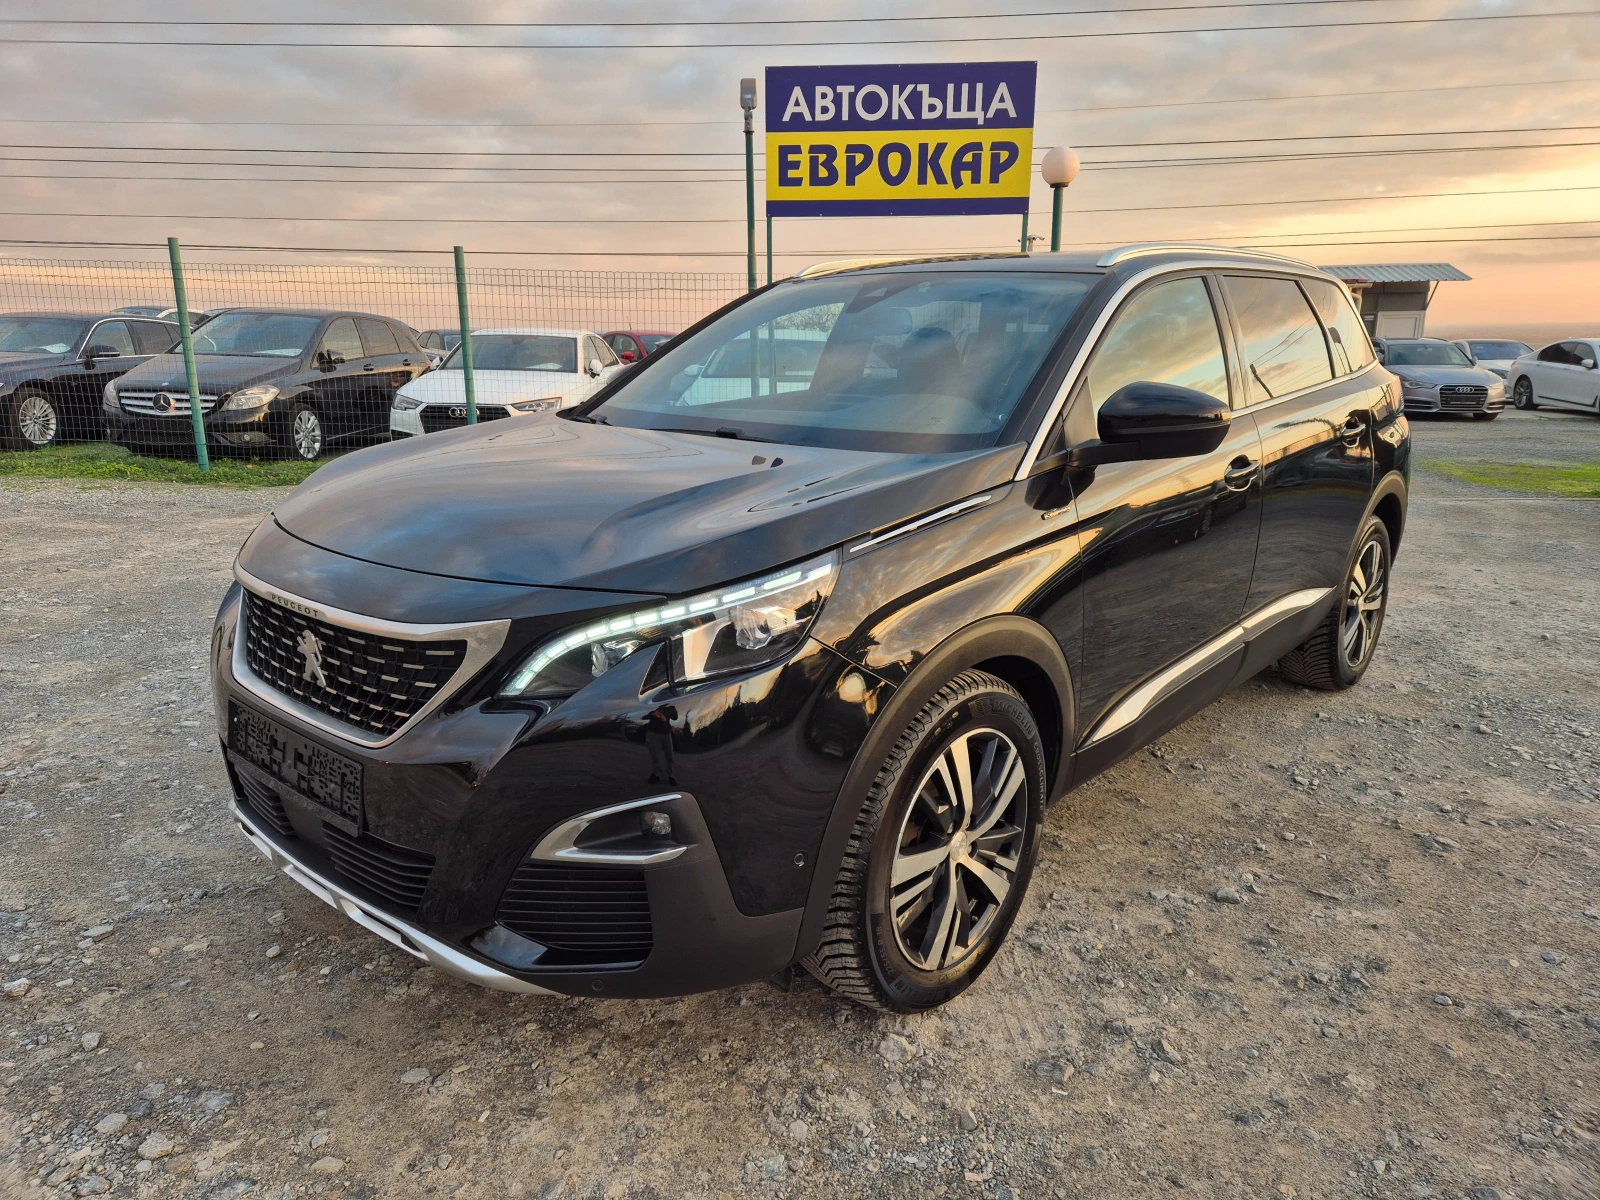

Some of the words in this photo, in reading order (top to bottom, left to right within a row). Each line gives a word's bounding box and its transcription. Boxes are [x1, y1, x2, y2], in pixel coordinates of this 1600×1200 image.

[782, 82, 1017, 125] АВТОКЪЩА
[778, 141, 1019, 190] ЕВРОКАР
[271, 593, 319, 617] PEUGEOT
[993, 699, 1036, 736] MICHELIN
